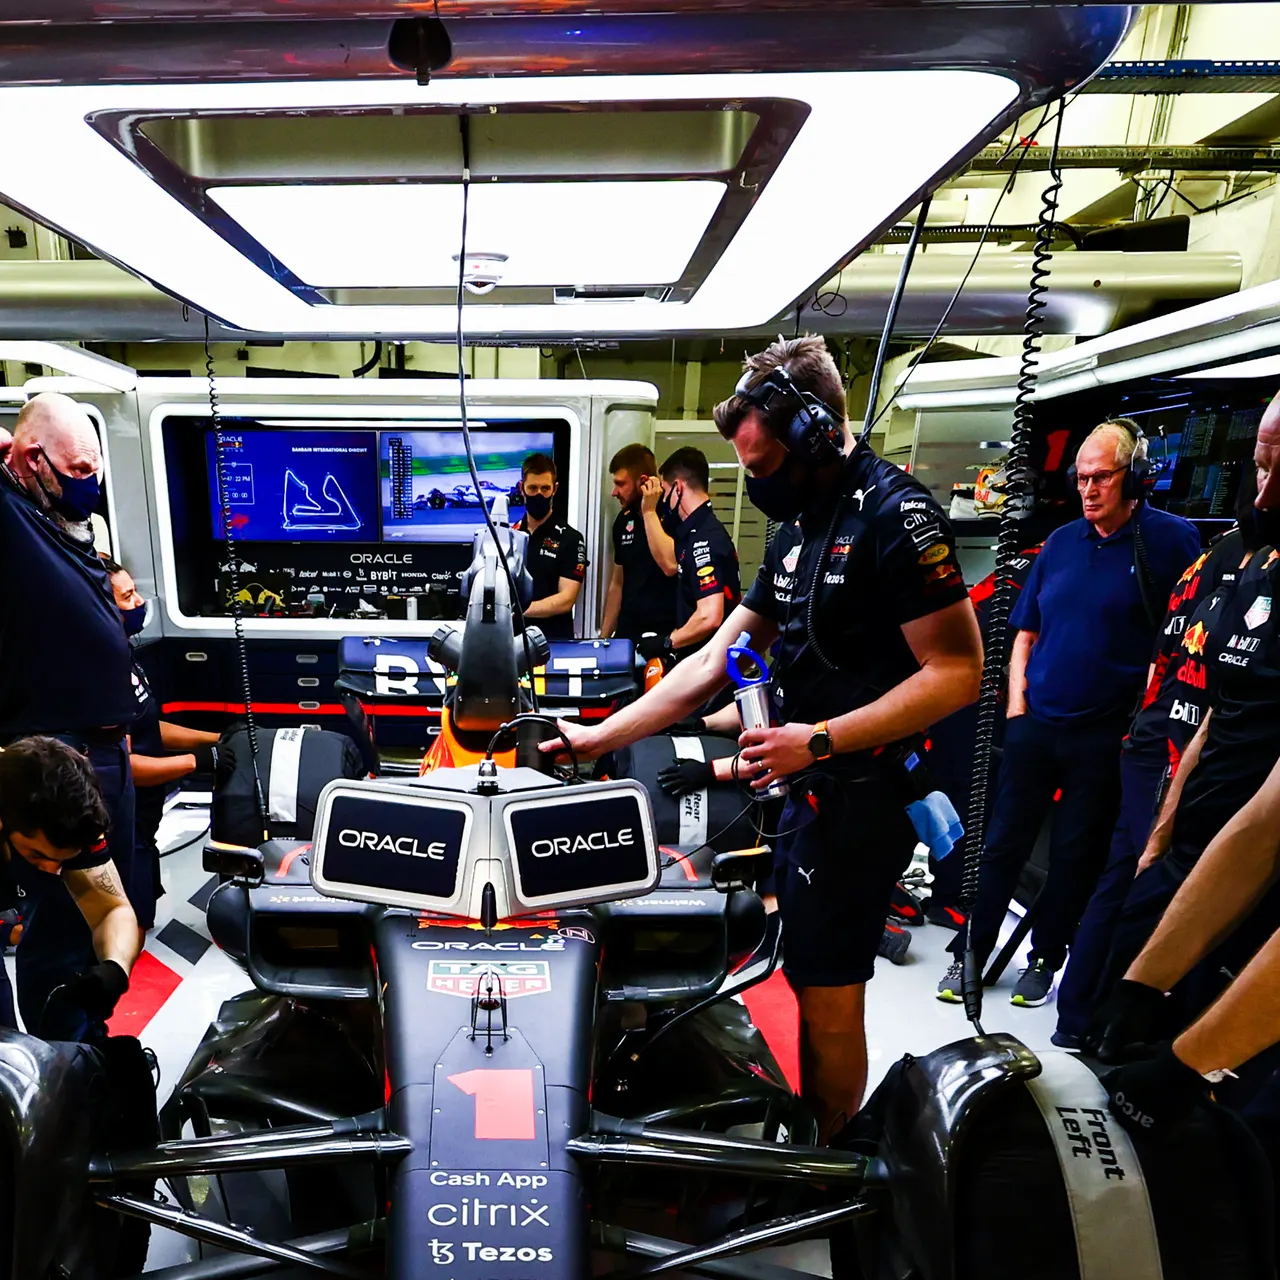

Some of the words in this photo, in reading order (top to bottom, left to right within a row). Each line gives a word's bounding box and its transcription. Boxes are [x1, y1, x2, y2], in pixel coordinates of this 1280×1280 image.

[1044, 430, 1069, 472] 1
[350, 554, 413, 564] ORACLE
[371, 569, 397, 580] BYBIT
[823, 572, 845, 584] Tezos
[693, 793, 702, 822] Rear
[338, 829, 446, 860] ORACLE
[531, 828, 635, 858] ORACLE
[412, 941, 566, 951] ORACLE
[439, 963, 538, 974] TAG
[447, 1069, 535, 1139] 1
[1055, 1107, 1092, 1158] Left
[1080, 1108, 1125, 1180] Front
[430, 1171, 490, 1187] Cash
[496, 1171, 548, 1189] App
[428, 1198, 550, 1227] citrix
[463, 1242, 553, 1262] Tezos
